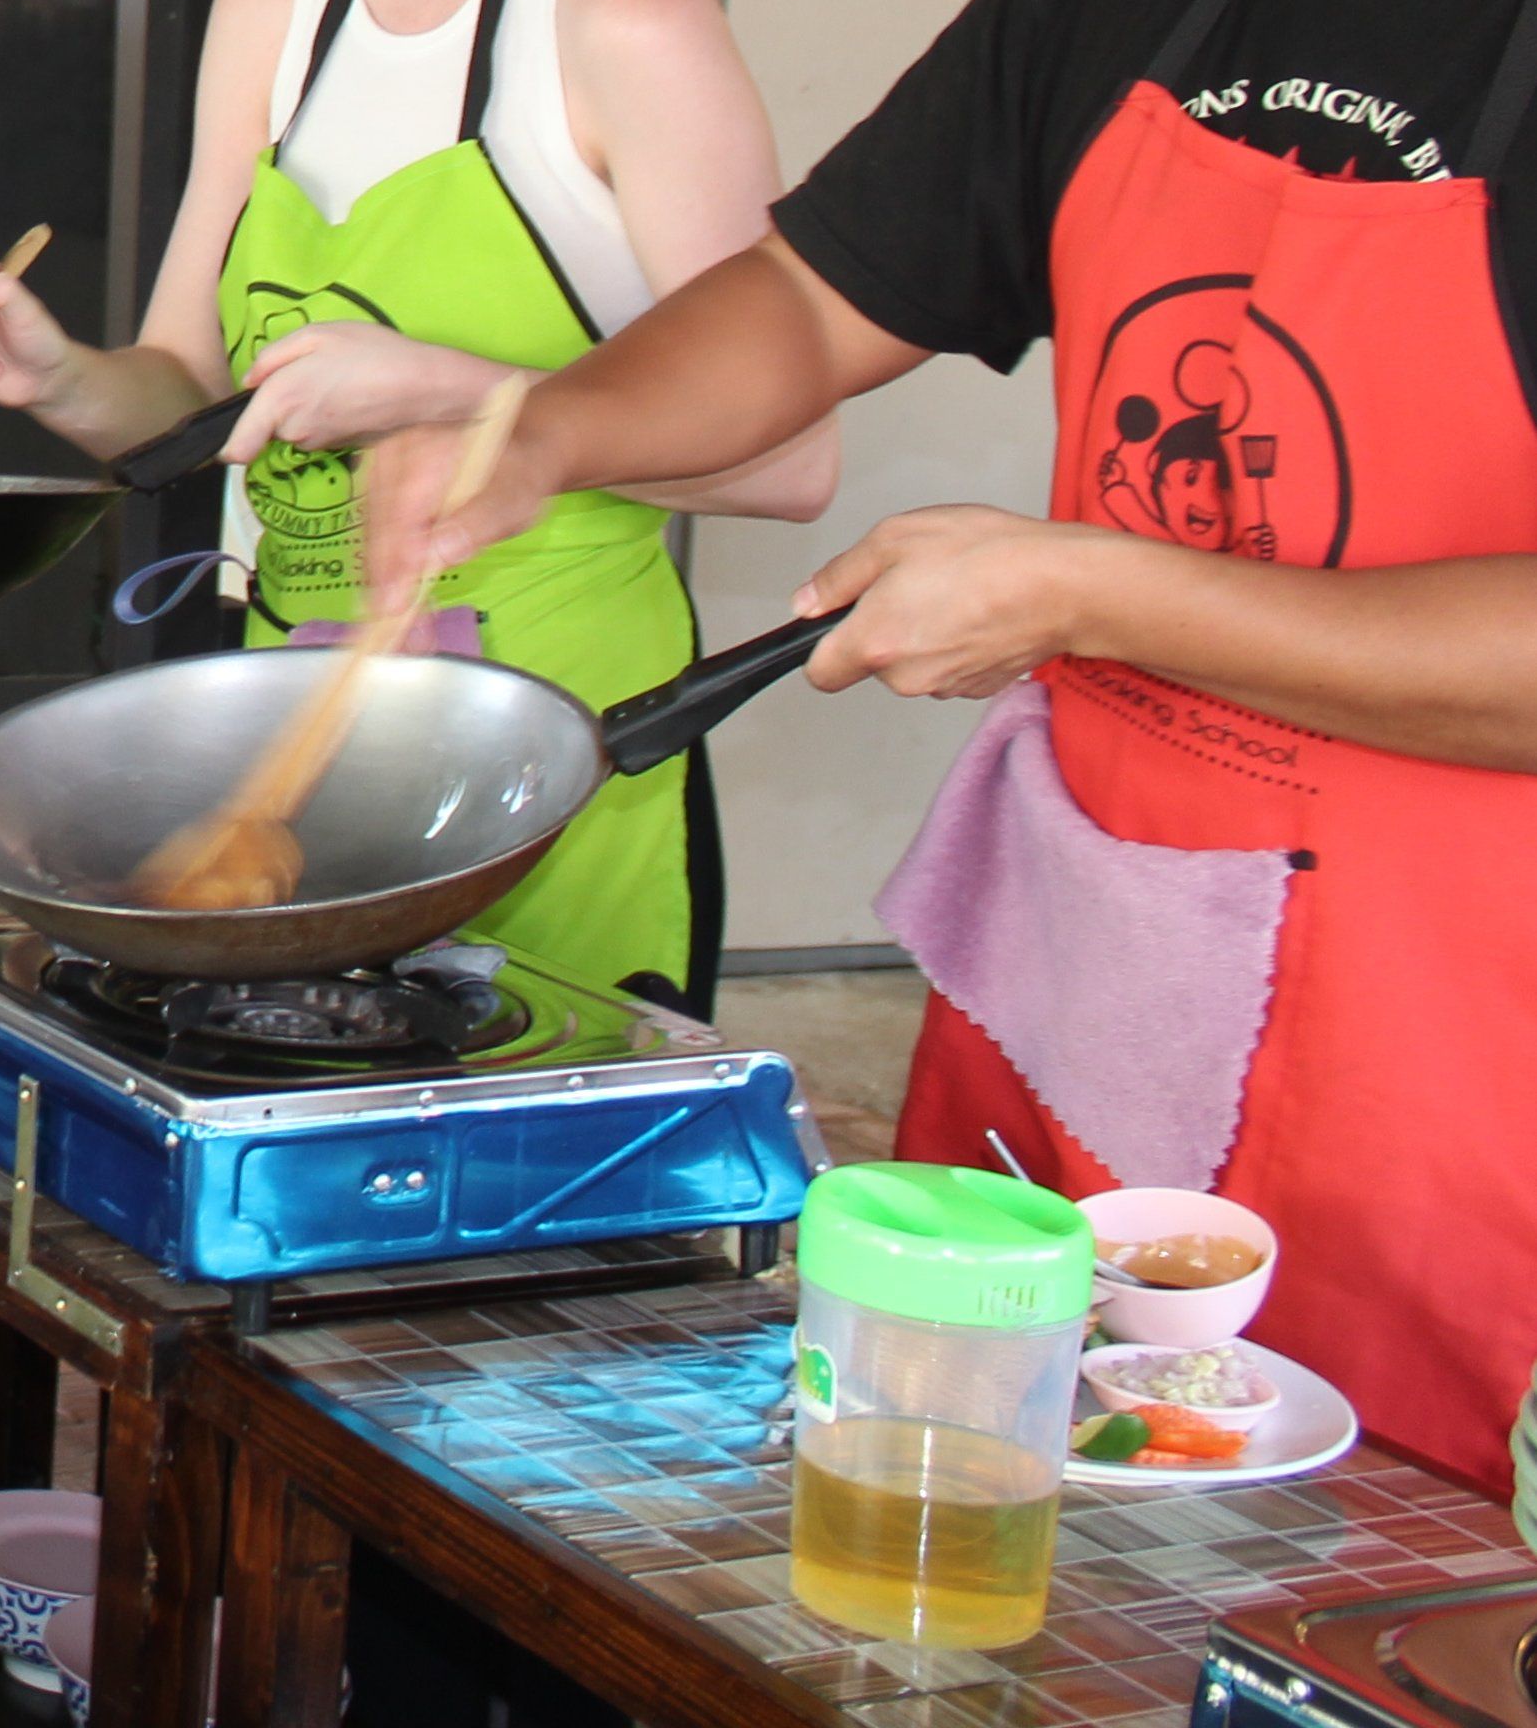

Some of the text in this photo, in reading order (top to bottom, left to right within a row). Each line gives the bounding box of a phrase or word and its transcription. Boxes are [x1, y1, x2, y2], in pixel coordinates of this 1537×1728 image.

[260, 497, 365, 536] YUMMY TAS
[1183, 708, 1299, 768] School
